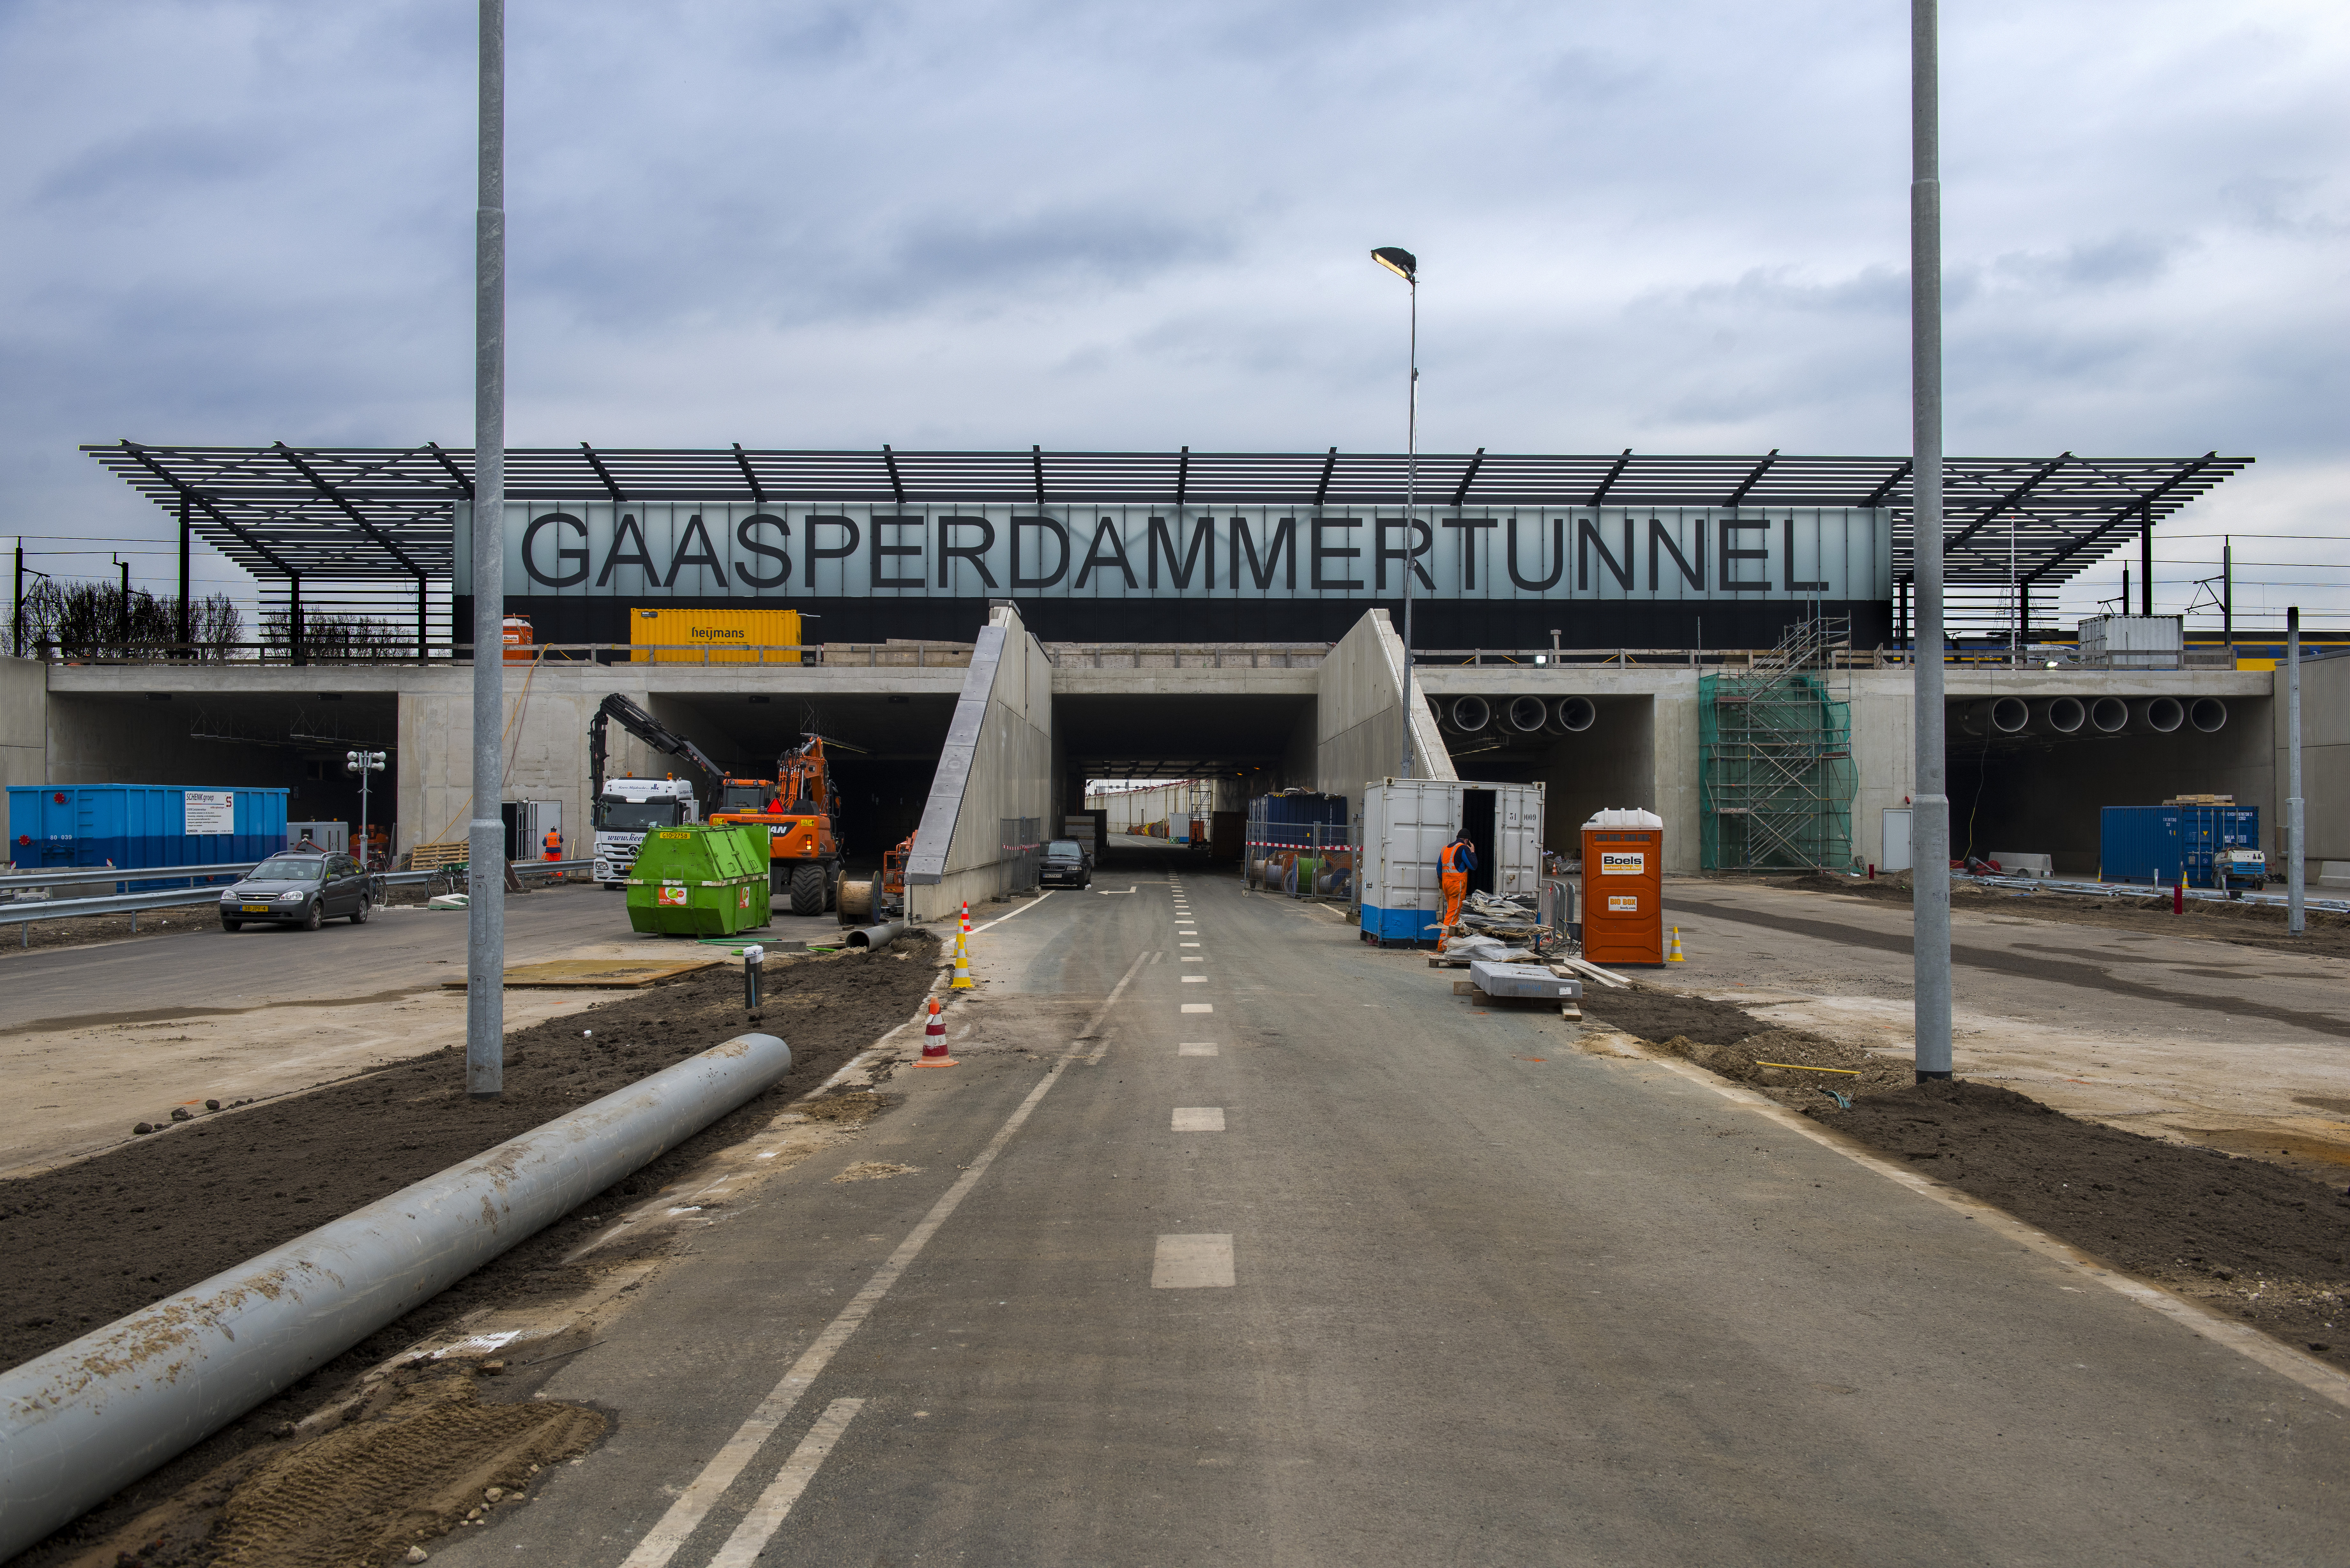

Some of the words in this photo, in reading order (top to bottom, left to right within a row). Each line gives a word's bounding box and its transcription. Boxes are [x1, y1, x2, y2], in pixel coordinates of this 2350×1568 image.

[521, 513, 1829, 591] GAASPERDAMMERTUNNEL
[692, 627, 745, 640] heijmans
[1604, 856, 1642, 864] Boels
